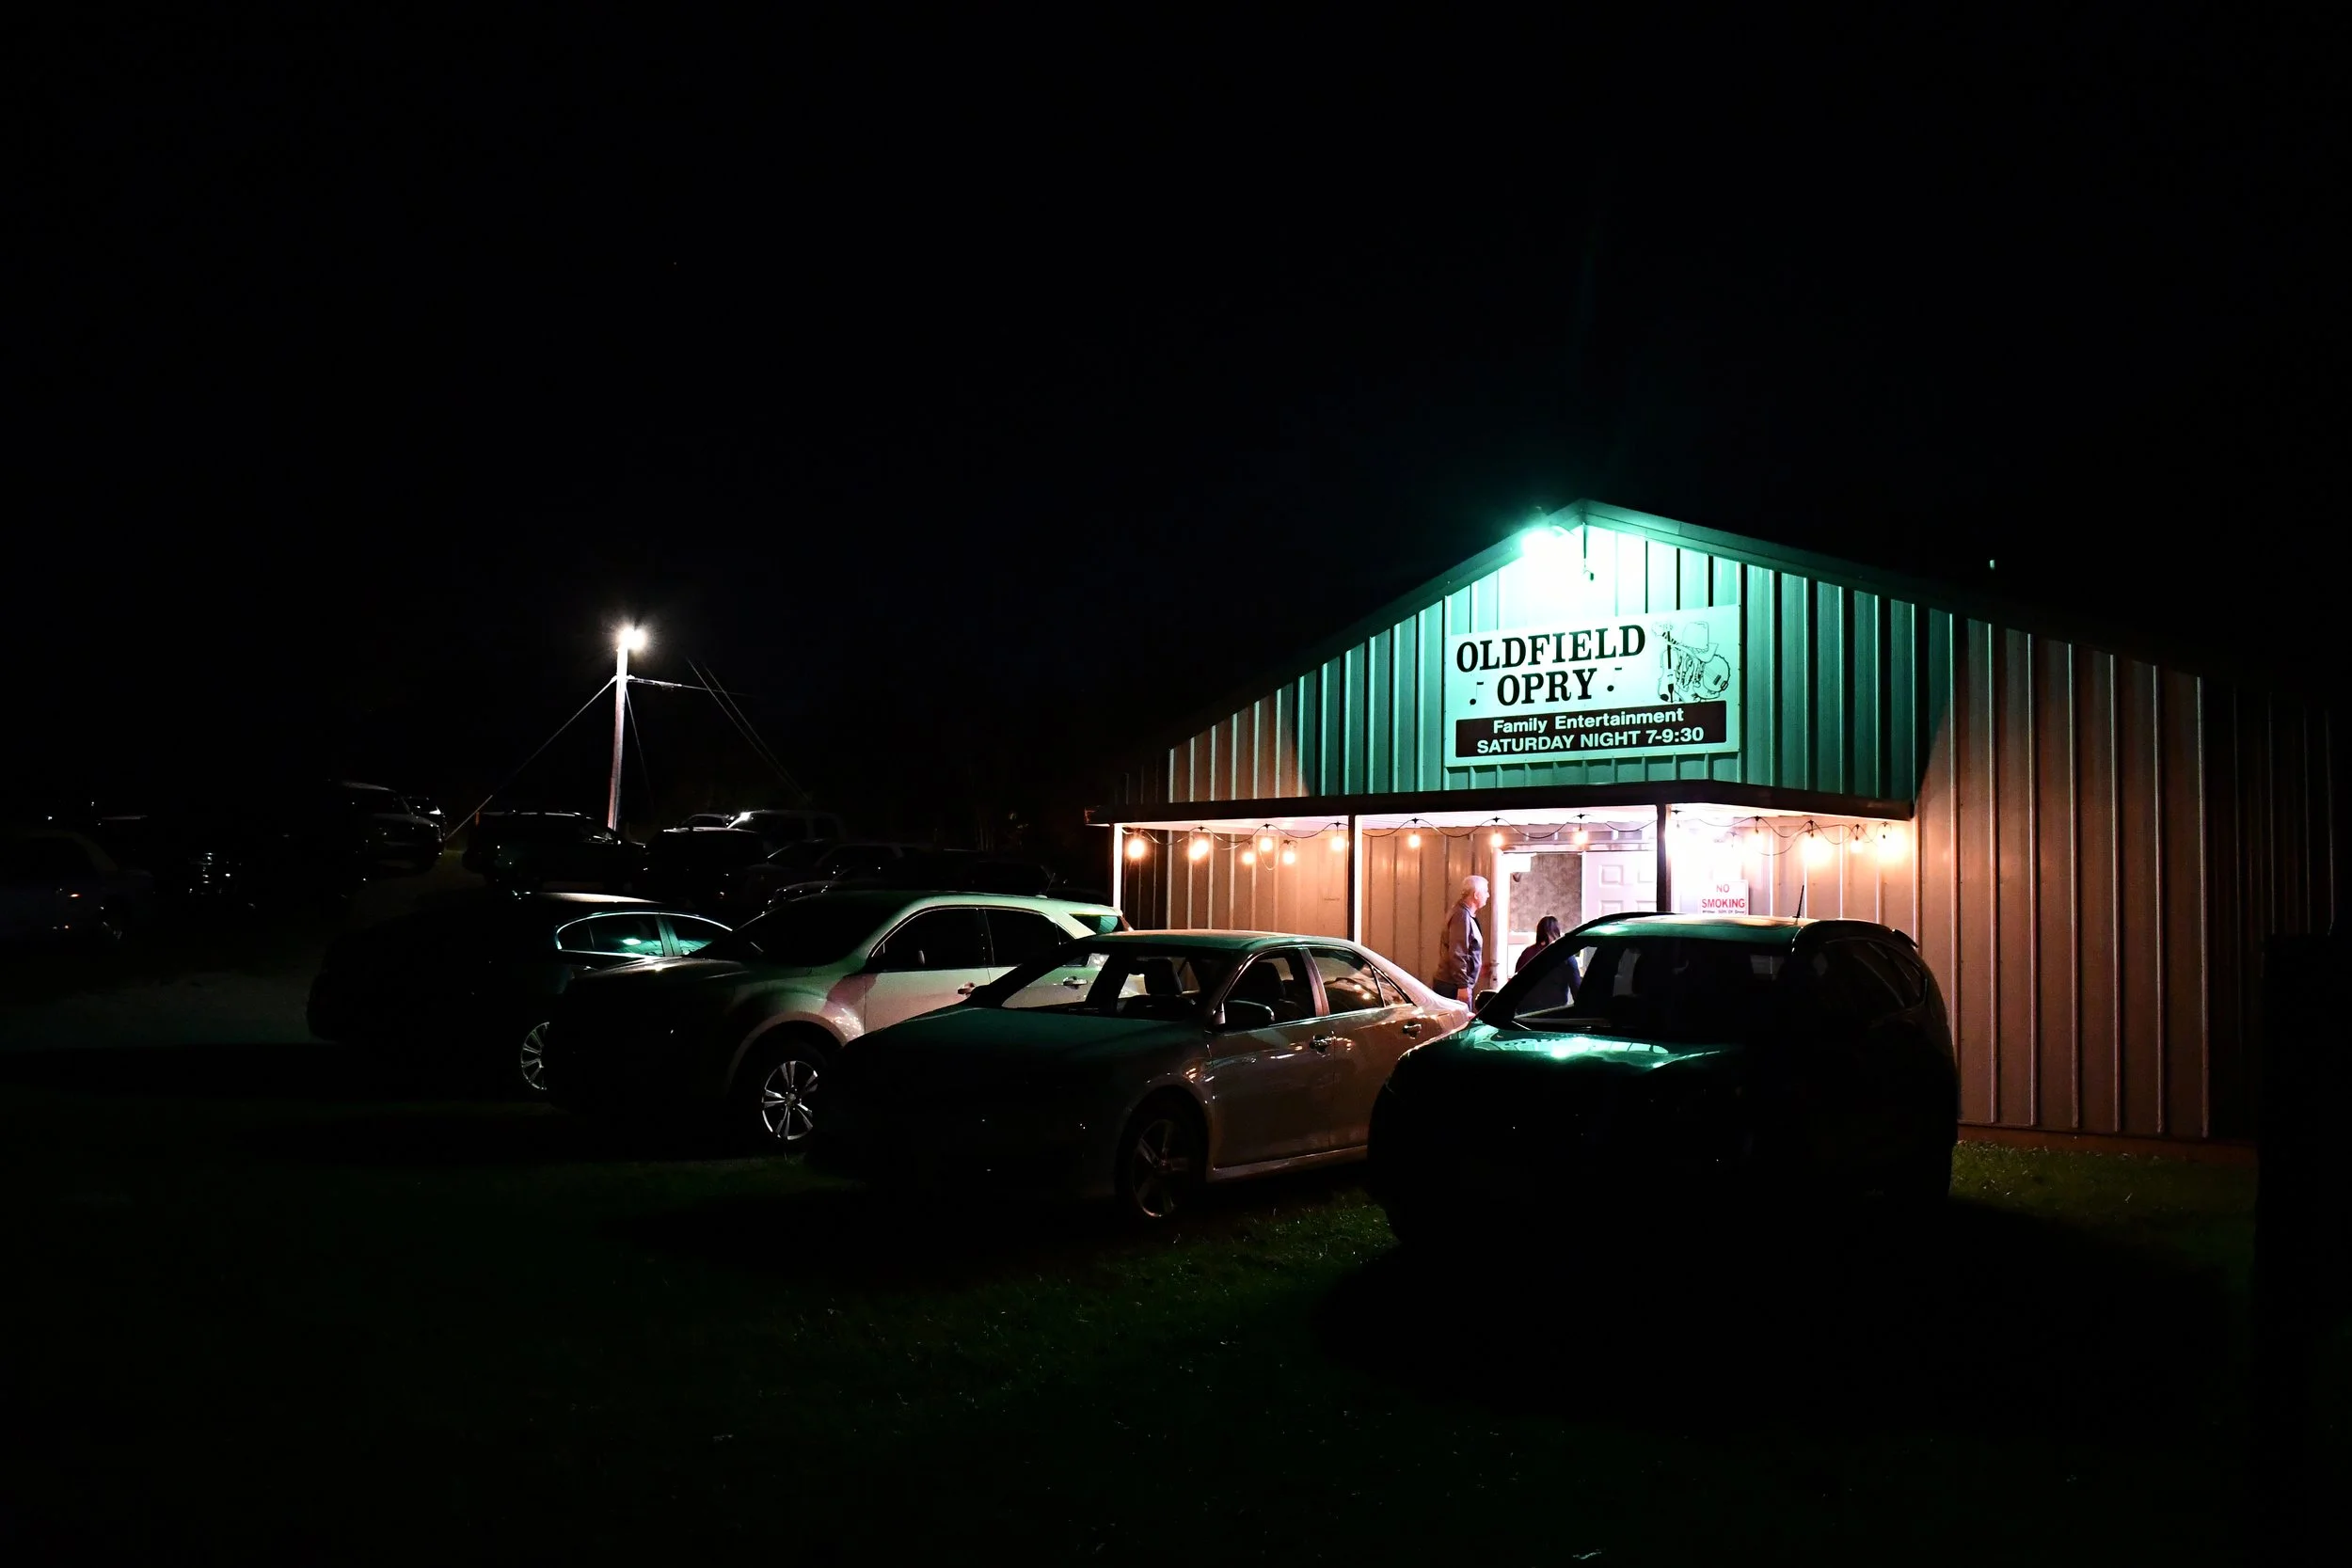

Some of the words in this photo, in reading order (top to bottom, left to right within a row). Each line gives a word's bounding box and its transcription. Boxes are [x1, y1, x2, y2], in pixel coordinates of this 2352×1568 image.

[1456, 624, 1645, 673] OLDFIELD
[1497, 667, 1597, 705] OPRY
[1493, 717, 1548, 736] Family
[1555, 706, 1684, 730] Entertainment
[1476, 735, 1574, 754] SATURDAY
[1580, 730, 1641, 748] NIGHT
[1645, 726, 1704, 744] 7-9:30
[1716, 883, 1730, 894] NO
[1701, 898, 1745, 909] SMOKING
